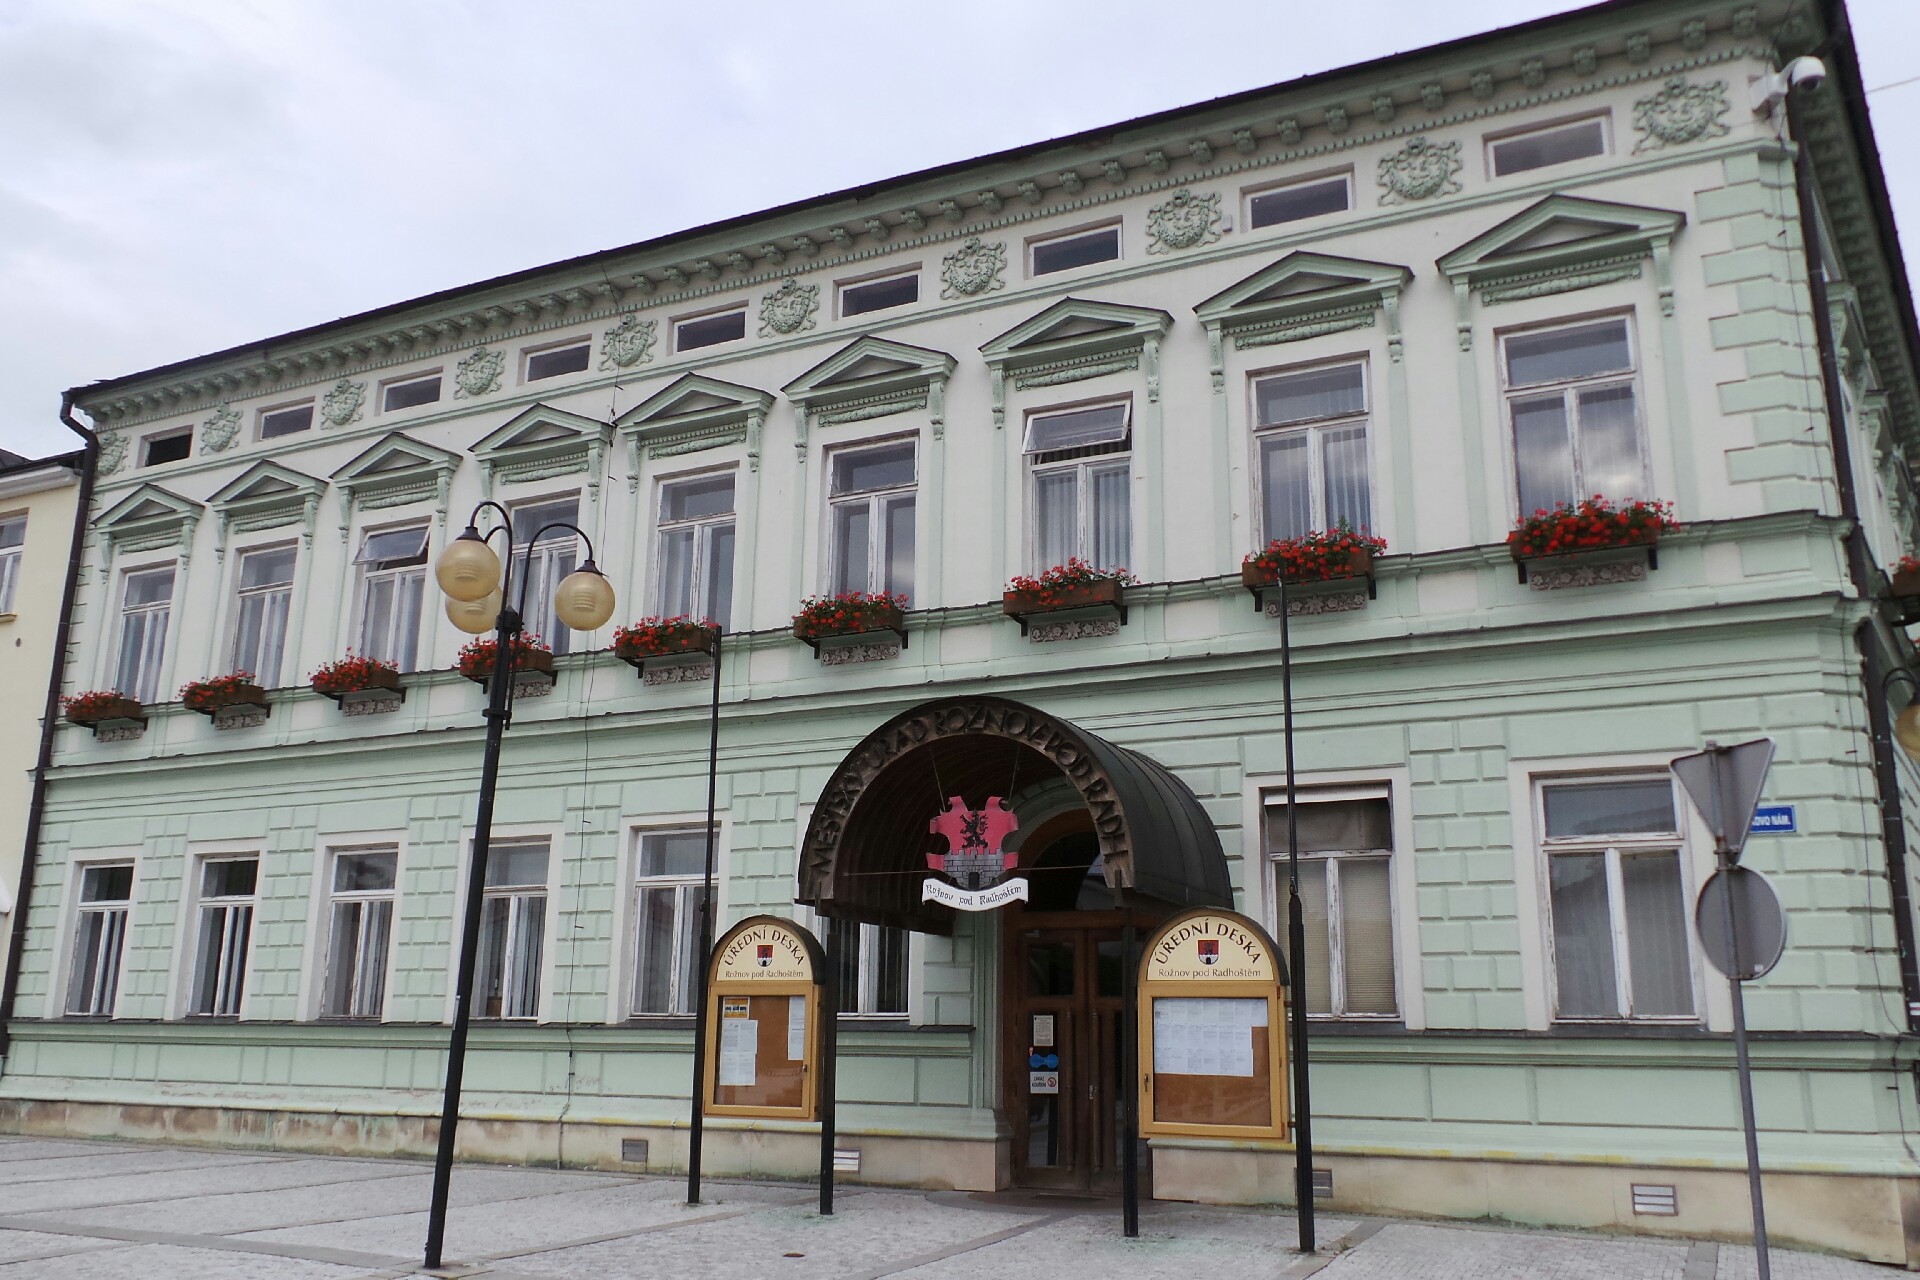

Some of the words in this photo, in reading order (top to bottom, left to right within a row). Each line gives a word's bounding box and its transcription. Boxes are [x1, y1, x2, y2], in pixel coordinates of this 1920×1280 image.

[934, 702, 1049, 740] ROŽNOV
[1044, 730, 1092, 777] POD
[958, 895, 973, 906] pod
[724, 925, 767, 966] ÚŘEDNÍ
[771, 930, 805, 965] DESKA
[1155, 917, 1209, 964] ÚŘEDNÍ
[1216, 923, 1261, 964] DESKA
[725, 970, 749, 978] Rožnov
[751, 969, 764, 979] pod
[766, 969, 804, 978] Radhoštěm
[1158, 968, 1190, 977] Rožnov
[1192, 968, 1210, 979] pod
[1212, 968, 1261, 977] Radhoštěm
